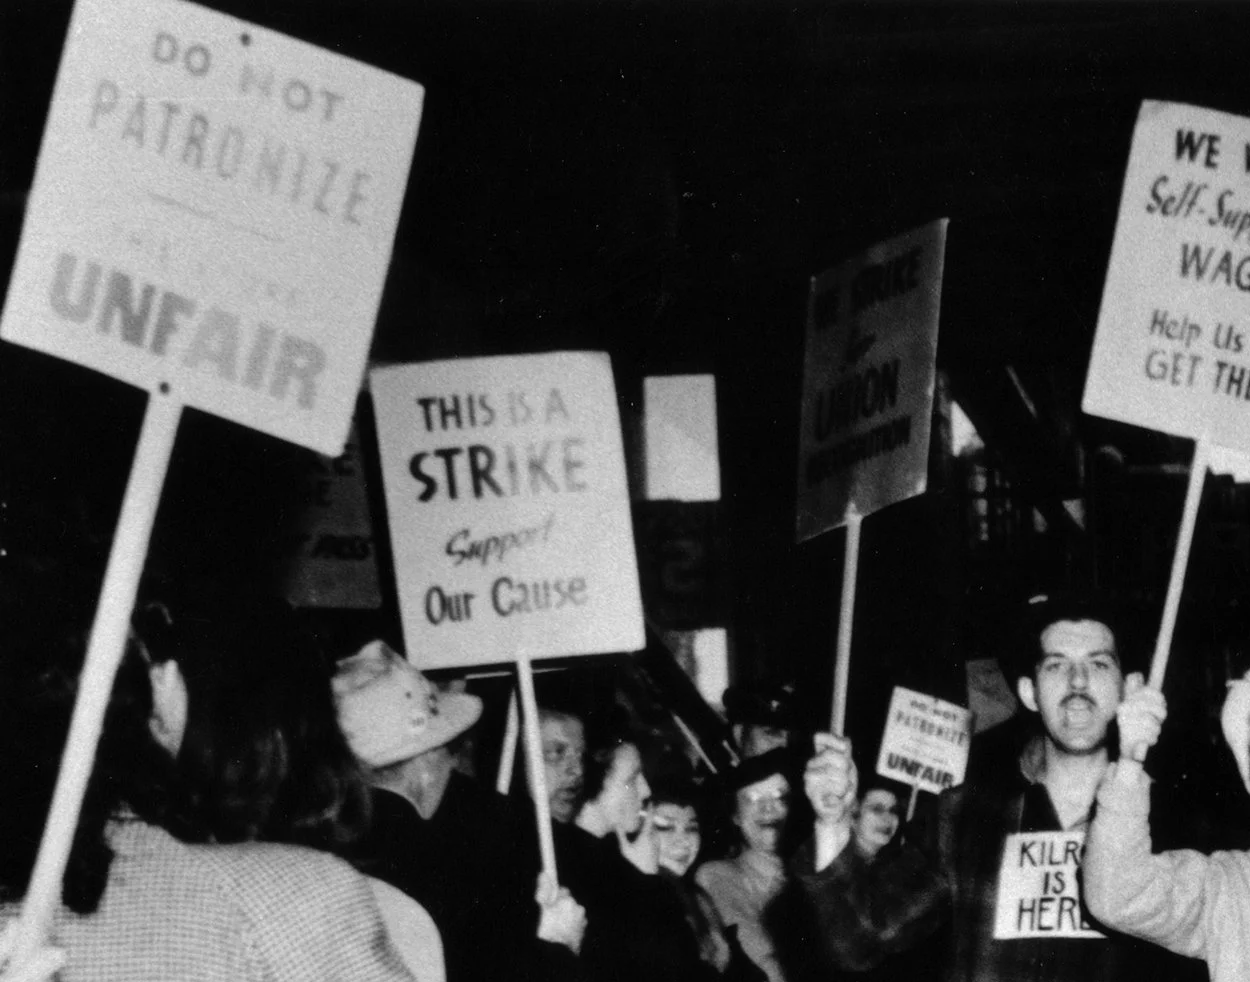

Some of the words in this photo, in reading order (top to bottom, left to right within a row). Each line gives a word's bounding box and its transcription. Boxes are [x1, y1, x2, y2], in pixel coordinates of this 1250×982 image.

[153, 31, 211, 78] DO
[239, 64, 344, 121] NOT
[88, 79, 370, 226] PATRONIZE
[1175, 127, 1221, 170] WE
[50, 253, 327, 412] UNFAIR
[1149, 309, 1202, 349] Help
[1213, 322, 1244, 353] Us
[1144, 348, 1202, 387] GET
[416, 393, 495, 432] THIS
[546, 387, 569, 425] A
[816, 359, 900, 441] UNION
[408, 437, 585, 503] STRIKE
[425, 585, 475, 627] Our
[491, 576, 587, 618] Cause
[887, 752, 954, 787] UNFAIR
[1019, 840, 1081, 868] KILR
[1043, 871, 1066, 895] IS
[1018, 896, 1089, 931] HER
